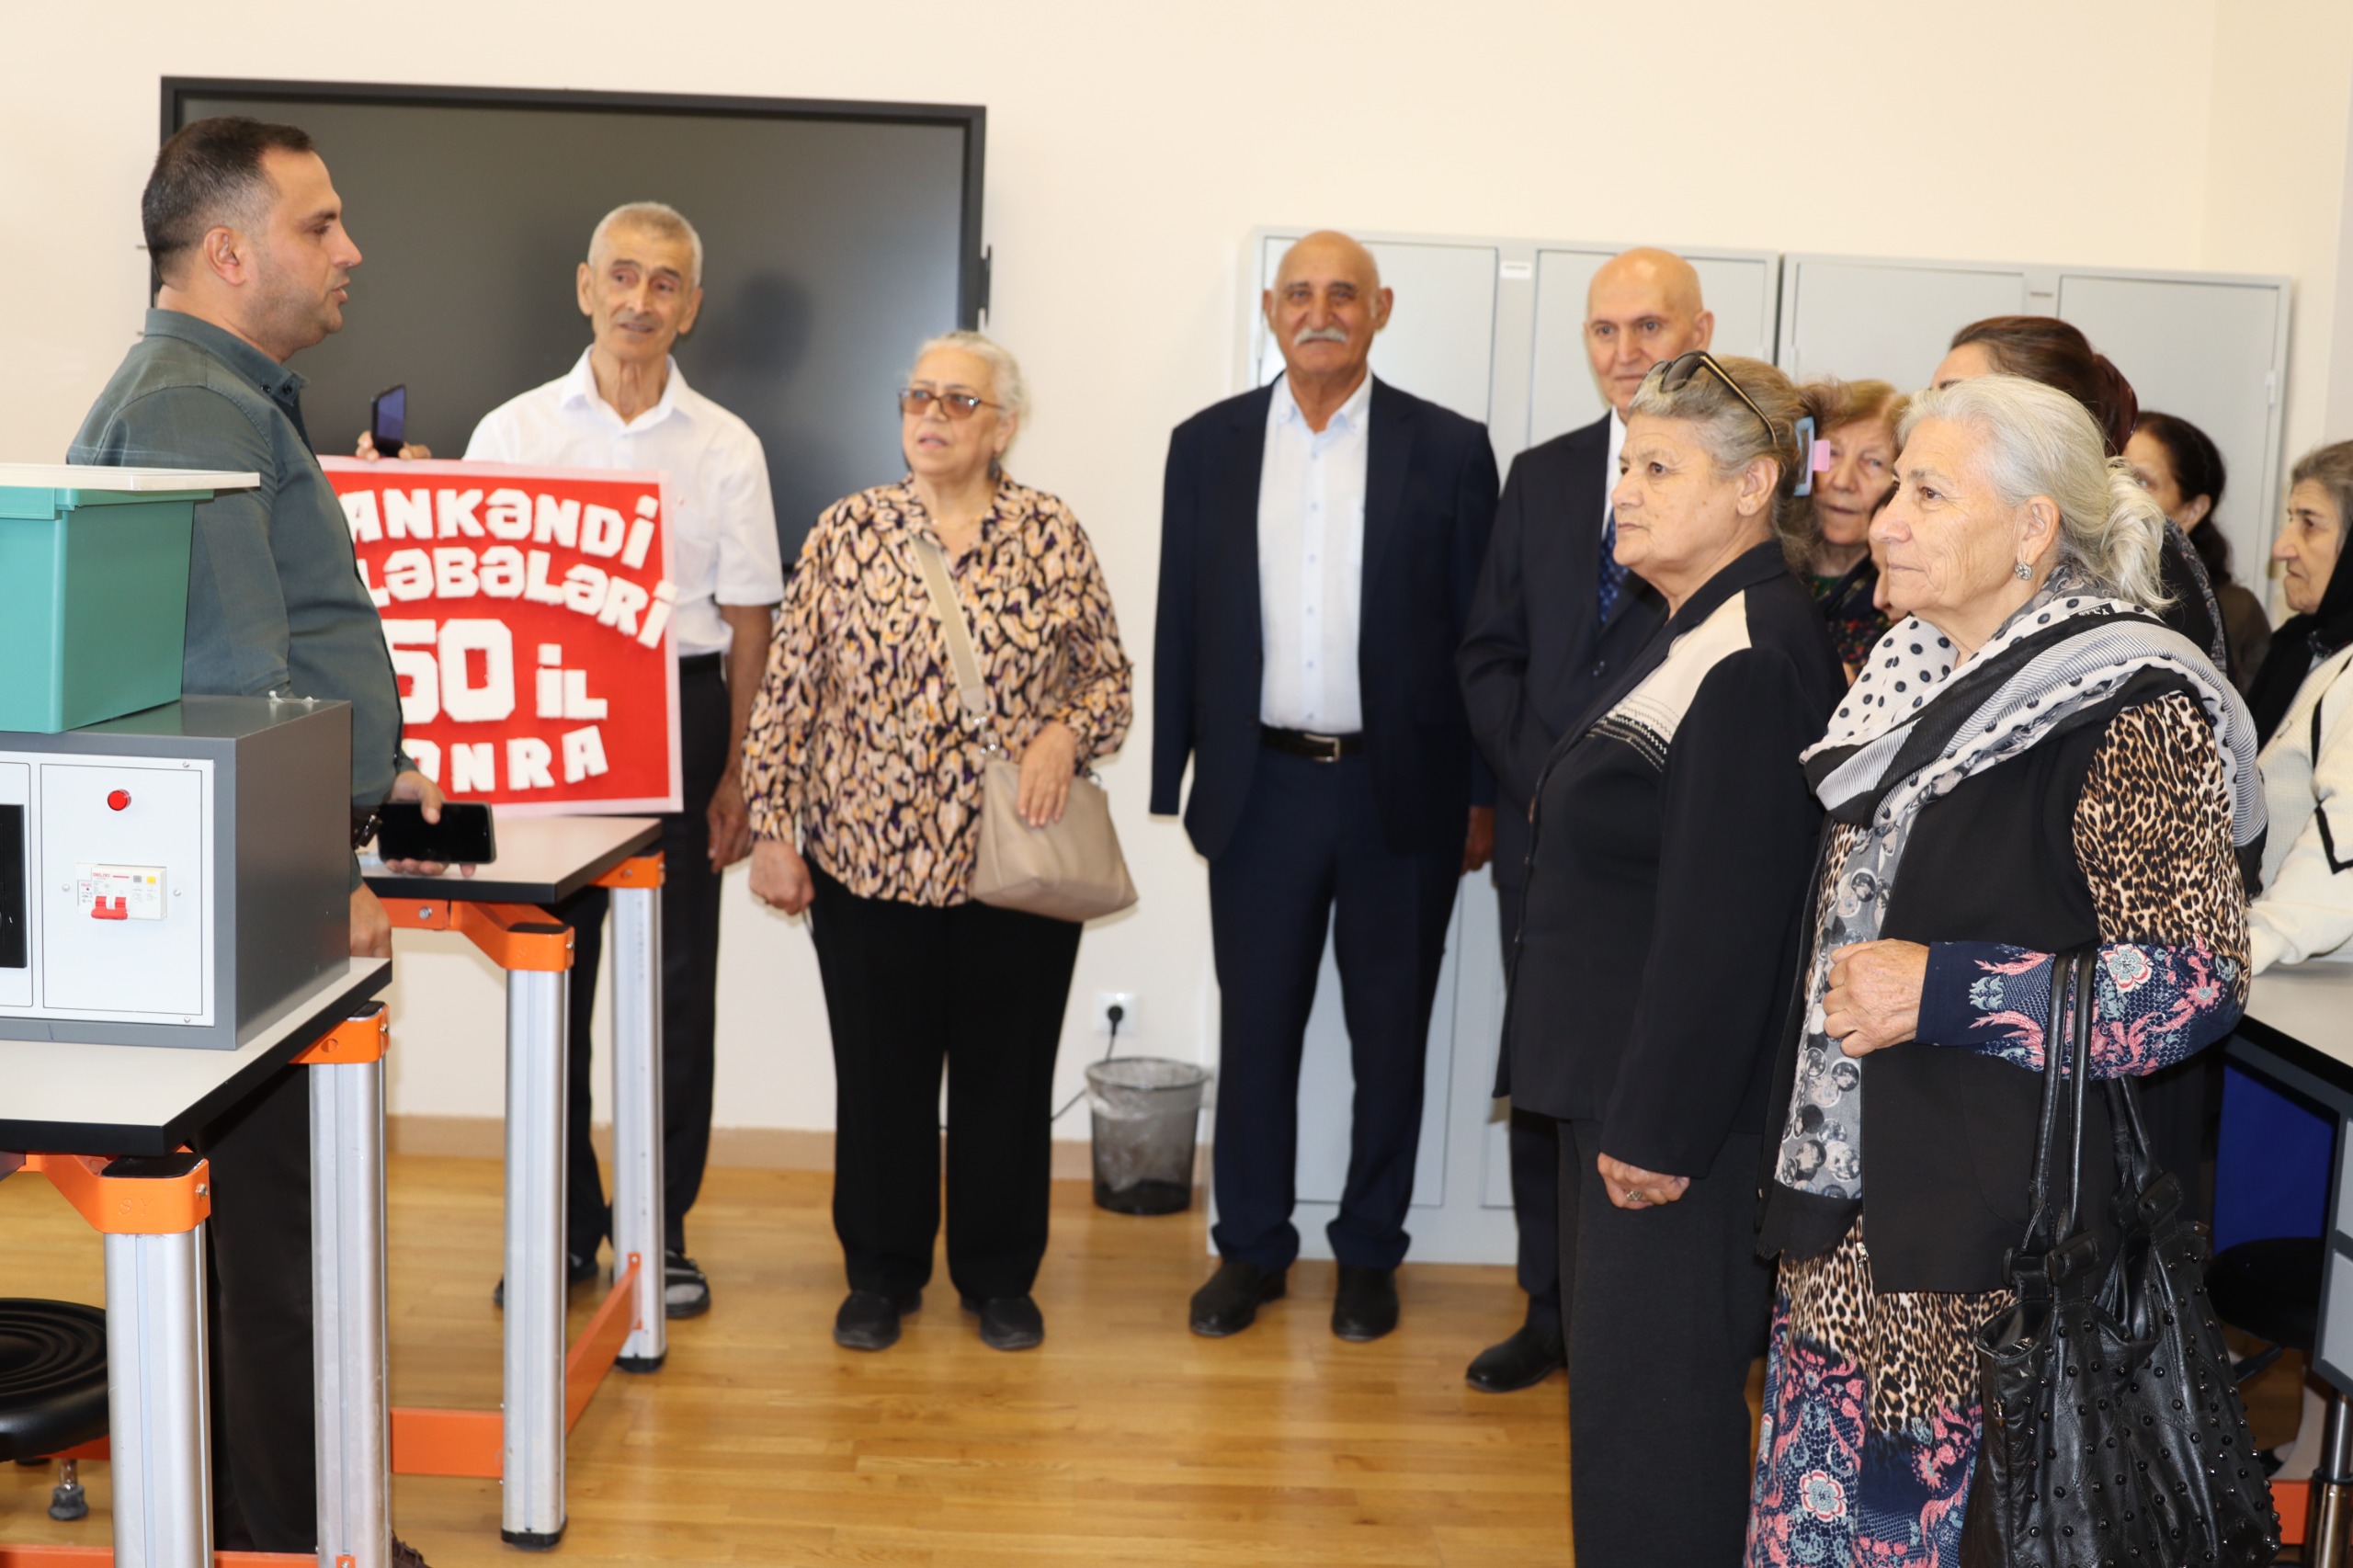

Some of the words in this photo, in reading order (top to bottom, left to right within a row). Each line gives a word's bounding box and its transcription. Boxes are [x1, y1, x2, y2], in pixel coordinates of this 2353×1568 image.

[338, 488, 659, 569] ANKƏNDİ
[356, 546, 678, 649] LƏBƏLƏRİ
[381, 618, 515, 724] 50
